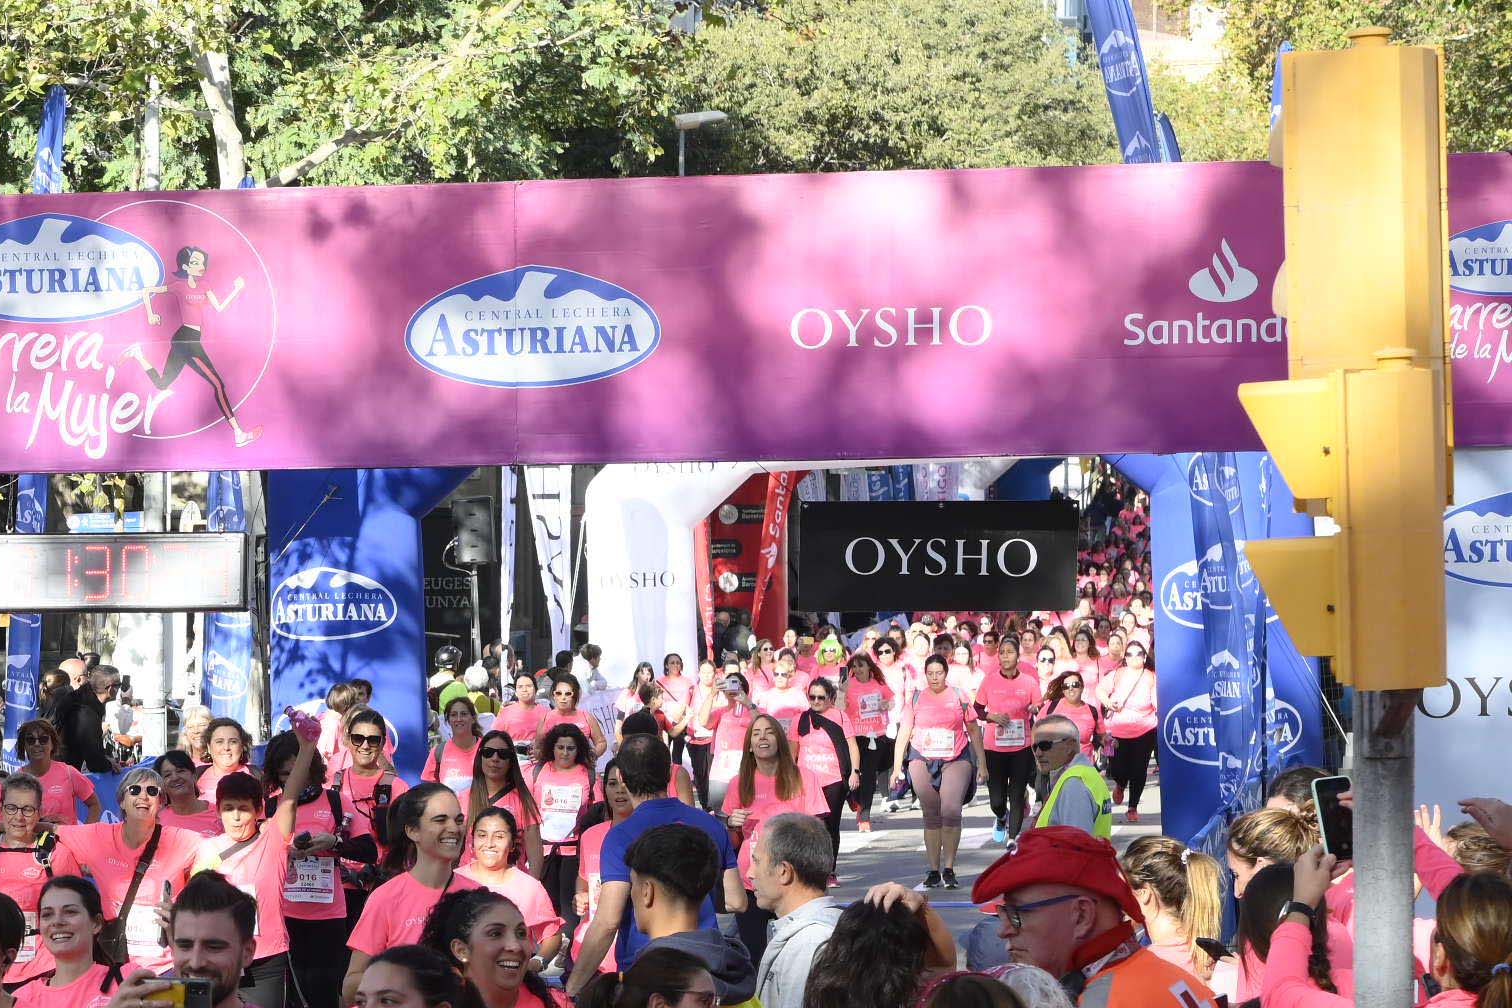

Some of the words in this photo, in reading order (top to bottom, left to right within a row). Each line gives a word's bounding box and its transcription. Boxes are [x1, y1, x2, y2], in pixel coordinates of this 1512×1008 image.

[463, 308, 544, 320] CENTRAL
[551, 305, 633, 318] LECHERA
[789, 305, 993, 351] OYSHO
[425, 312, 641, 359] ASTURIANA
[5, 373, 31, 415] la
[26, 366, 175, 459] Mujer
[844, 536, 1039, 579] OYSHO
[275, 600, 388, 625] ASTURIANA
[287, 593, 329, 601] CENTRAL
[333, 592, 383, 600] LECHERA
[299, 873, 317, 882] 016
